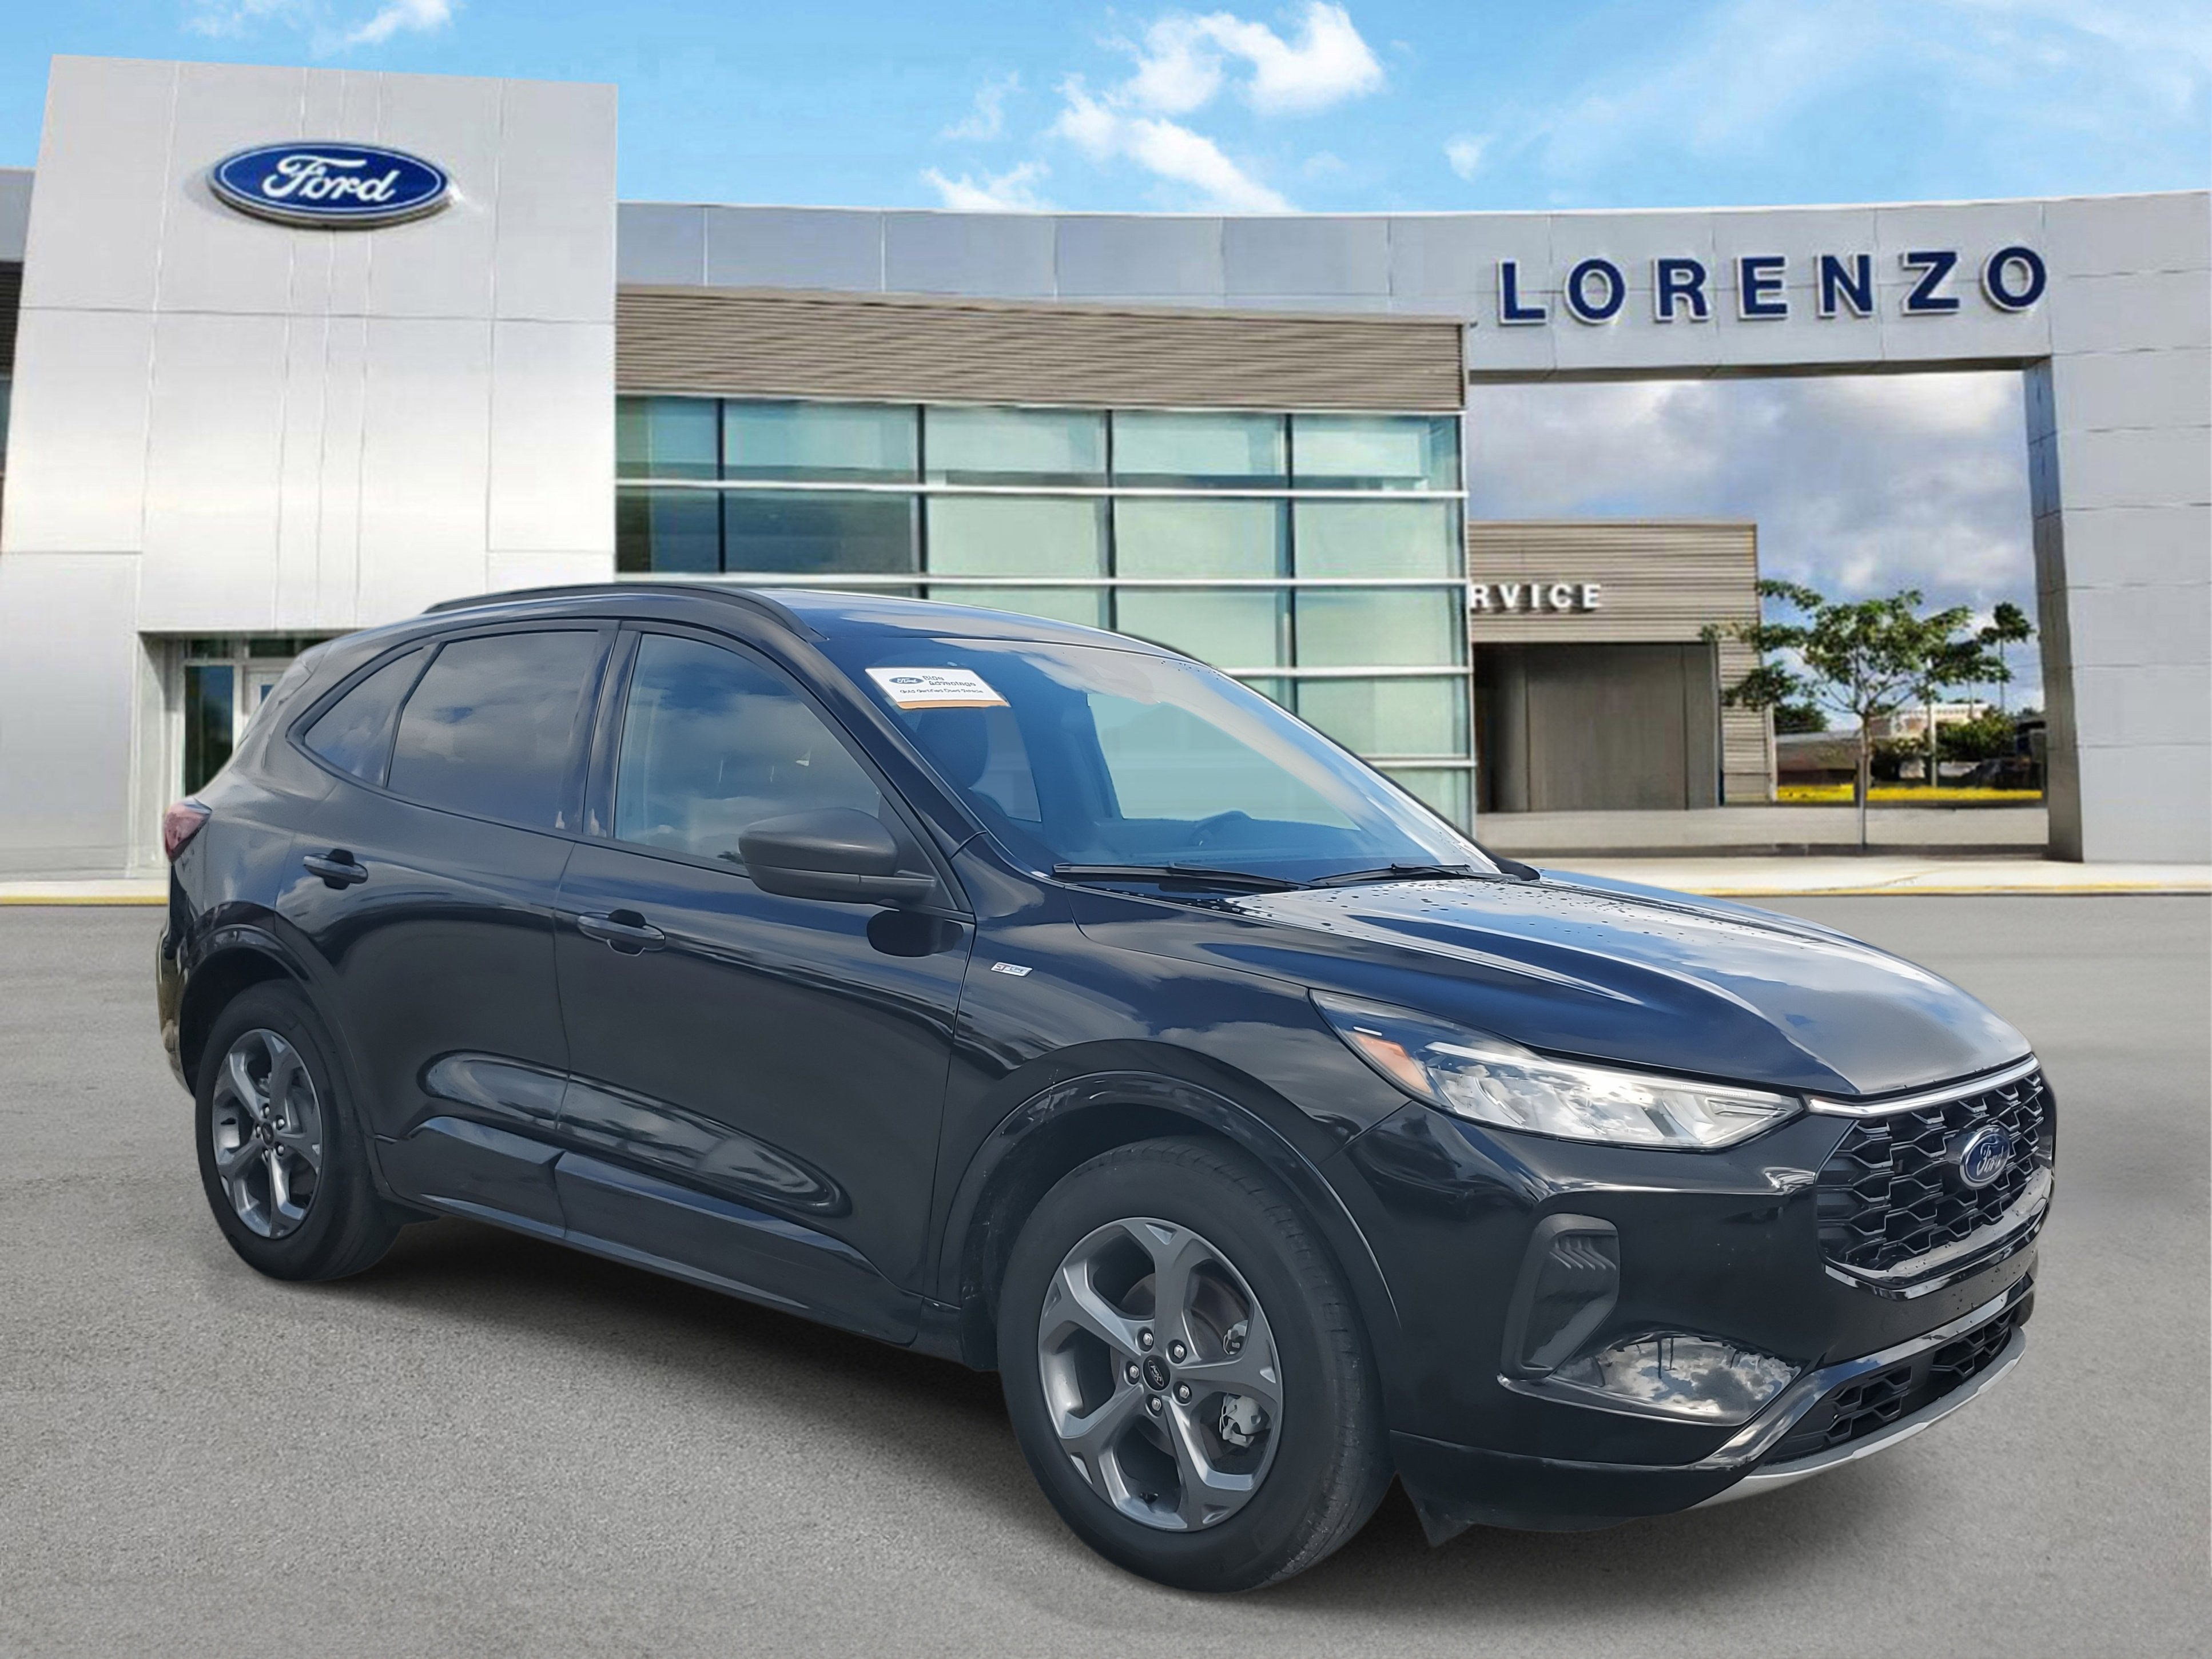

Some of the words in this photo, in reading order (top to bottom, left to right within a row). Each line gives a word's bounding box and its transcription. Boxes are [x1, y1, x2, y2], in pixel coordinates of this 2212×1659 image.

[262, 154, 400, 202] Ford
[1497, 245, 2047, 324] LORENZO
[1977, 1141, 2004, 1176] Ford
